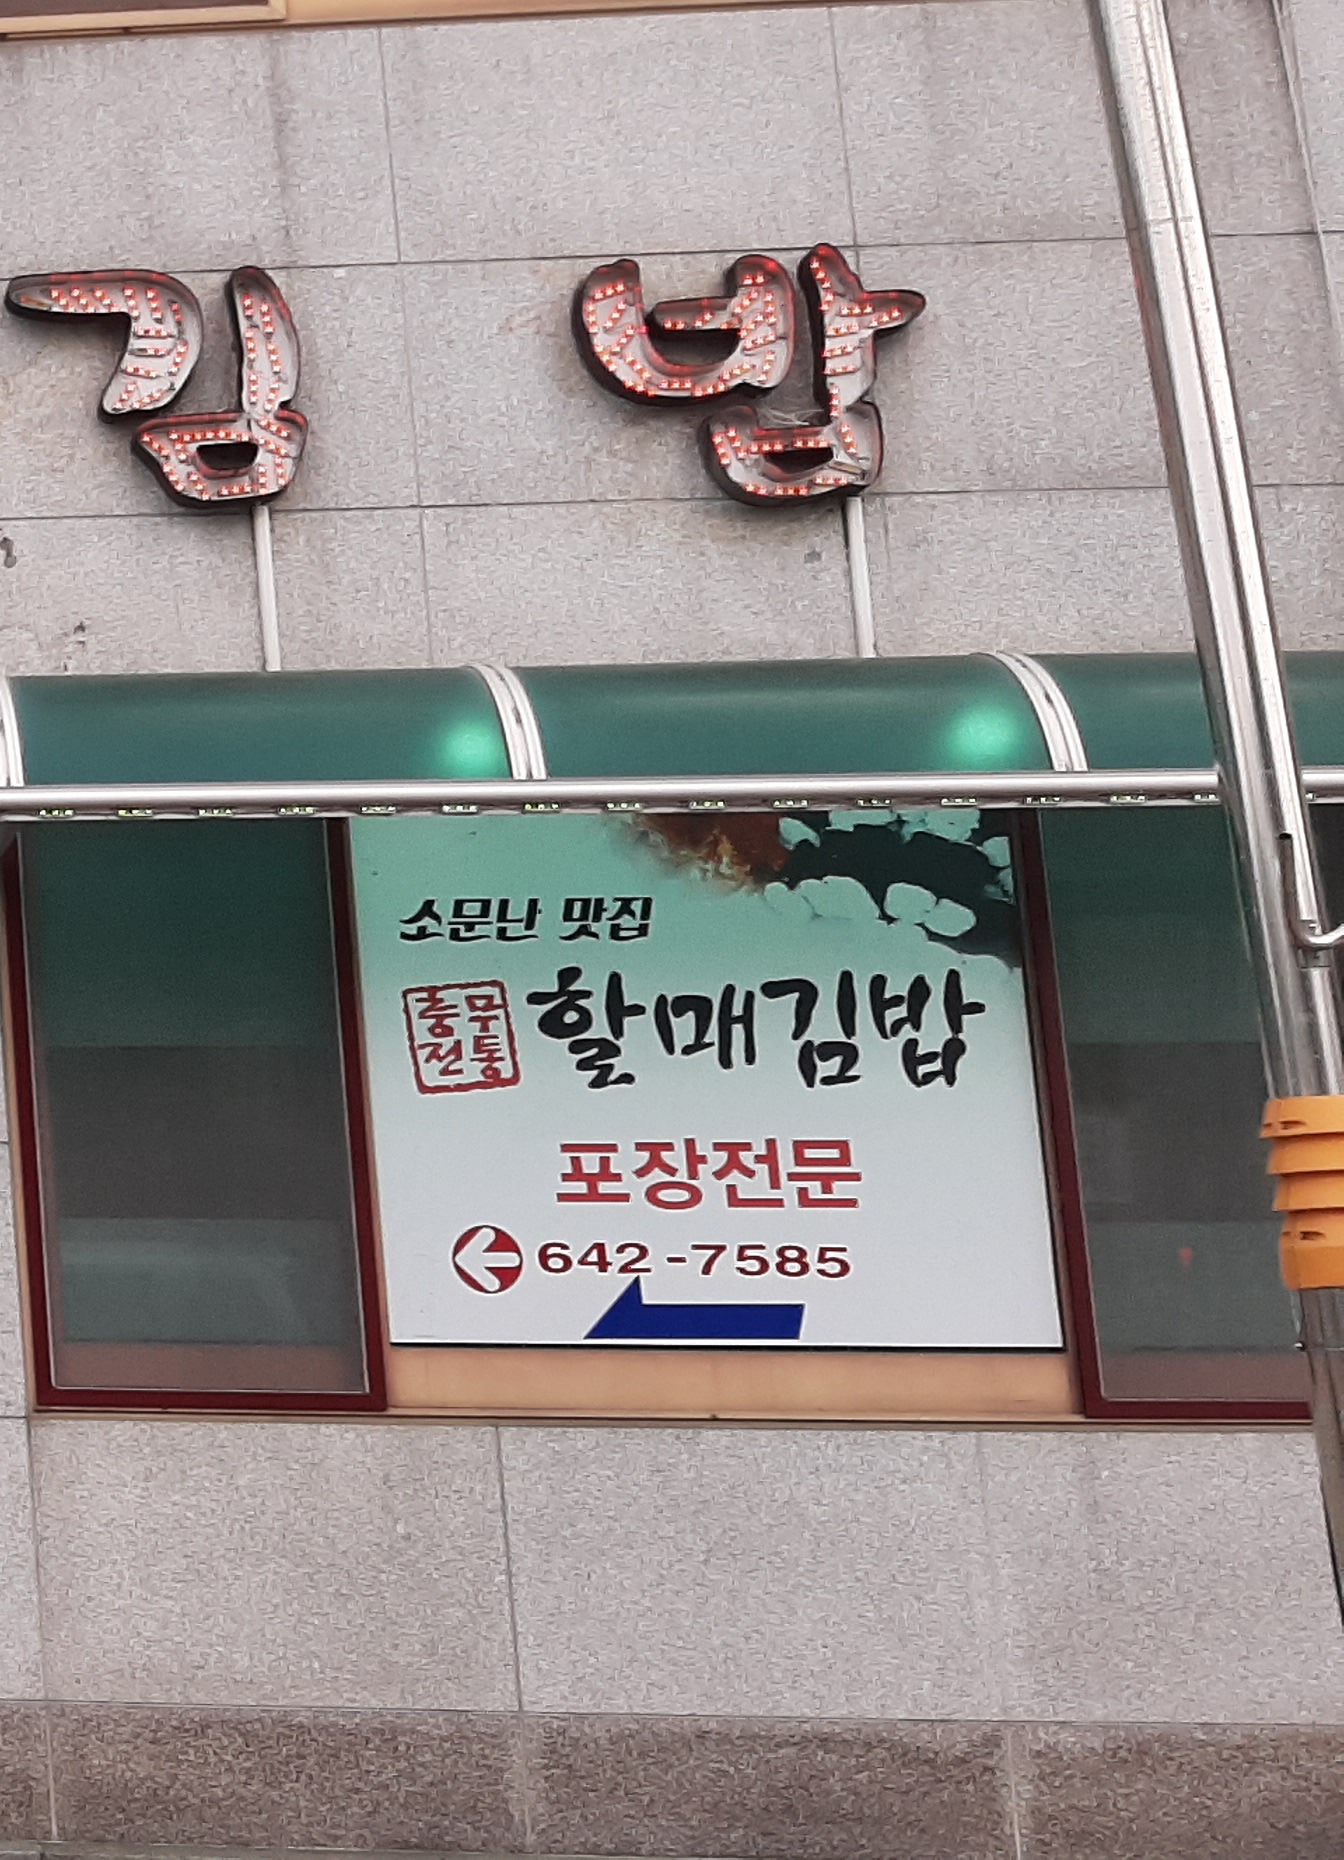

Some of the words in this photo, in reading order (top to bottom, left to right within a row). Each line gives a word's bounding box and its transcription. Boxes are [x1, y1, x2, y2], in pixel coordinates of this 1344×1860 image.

[399, 897, 542, 942] 소문난
[559, 897, 653, 942] 맛집
[415, 984, 506, 1036] 충무
[526, 966, 986, 1088] 할매김밥
[418, 1033, 508, 1082] 전통
[556, 1137, 863, 1210] 포장전문
